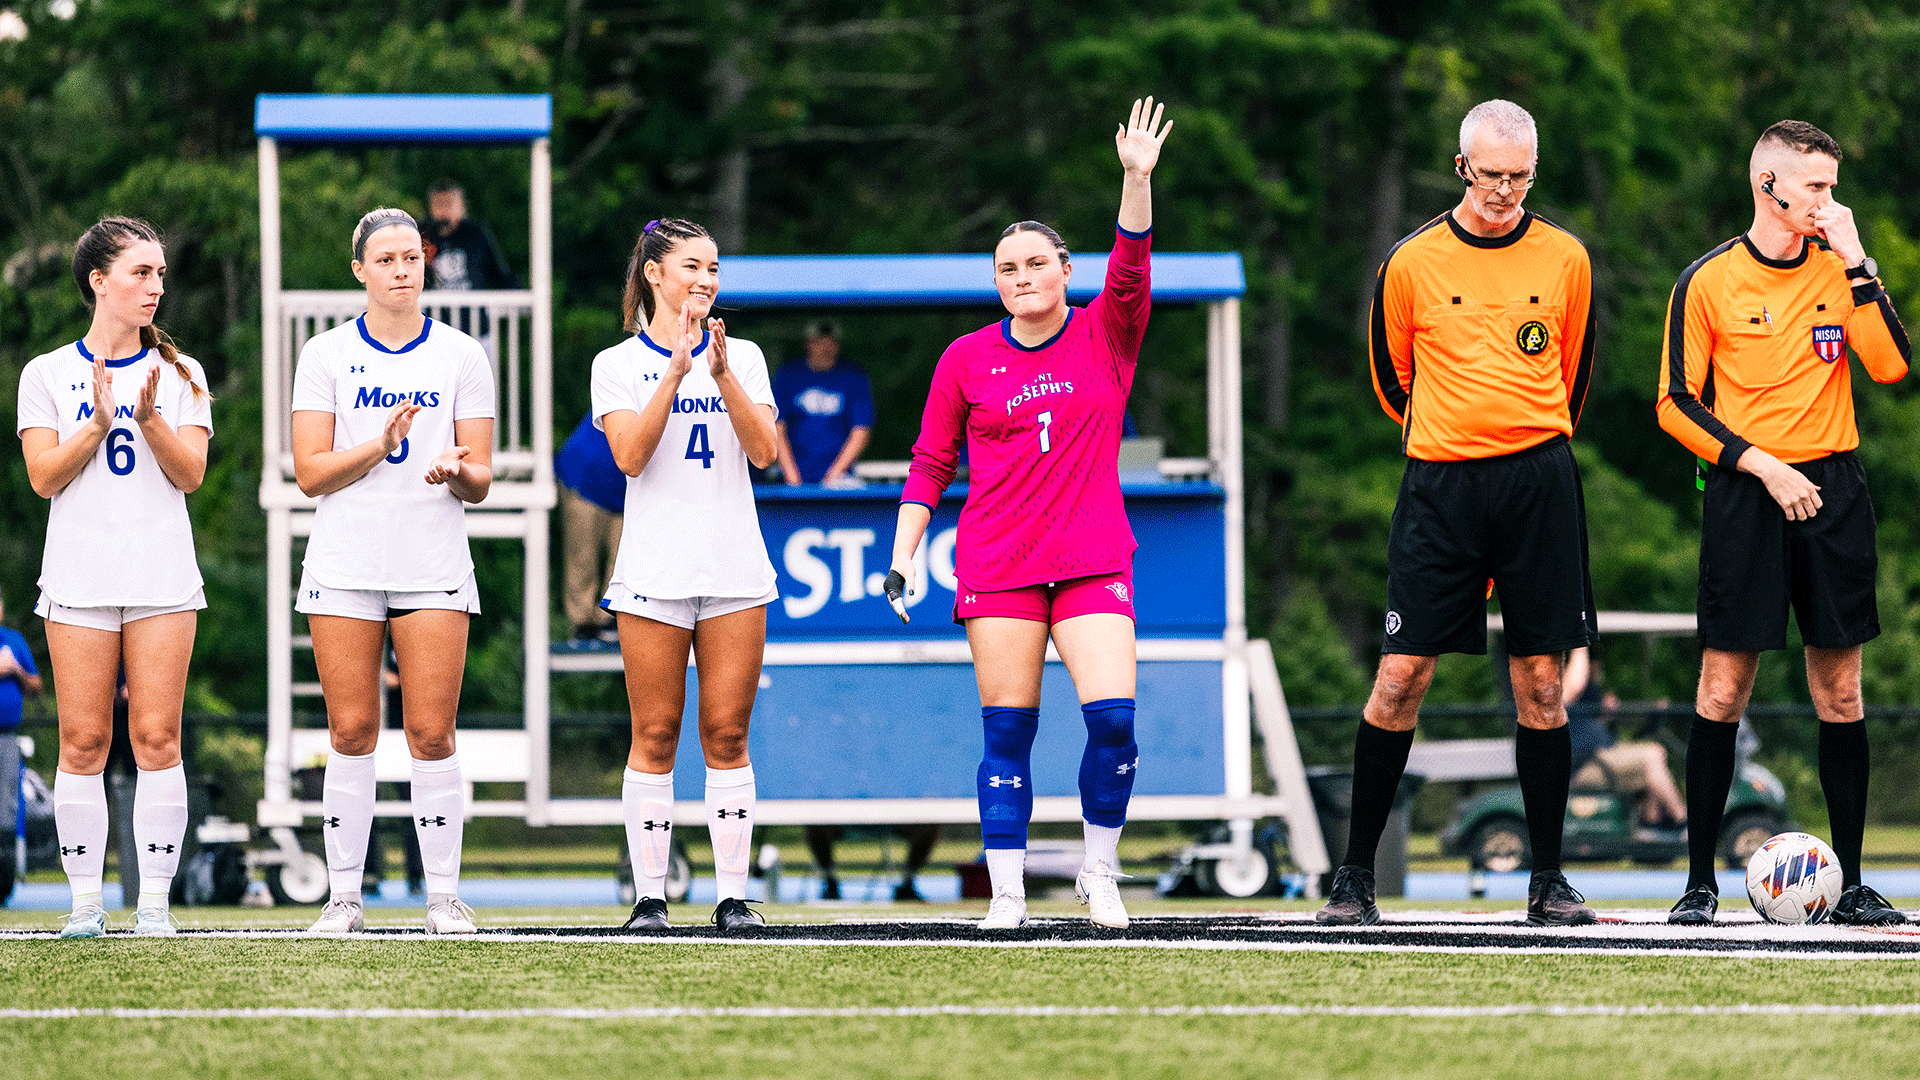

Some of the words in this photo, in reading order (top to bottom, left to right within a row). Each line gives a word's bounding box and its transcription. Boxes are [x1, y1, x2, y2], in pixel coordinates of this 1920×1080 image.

[1815, 329, 1842, 341] NISOA
[1006, 381, 1074, 417] JOSEPH'S
[1022, 372, 1052, 392] SNT
[672, 392, 728, 413] ONK
[685, 423, 715, 469] 4
[1037, 410, 1052, 453] 1
[106, 427, 136, 476] 6
